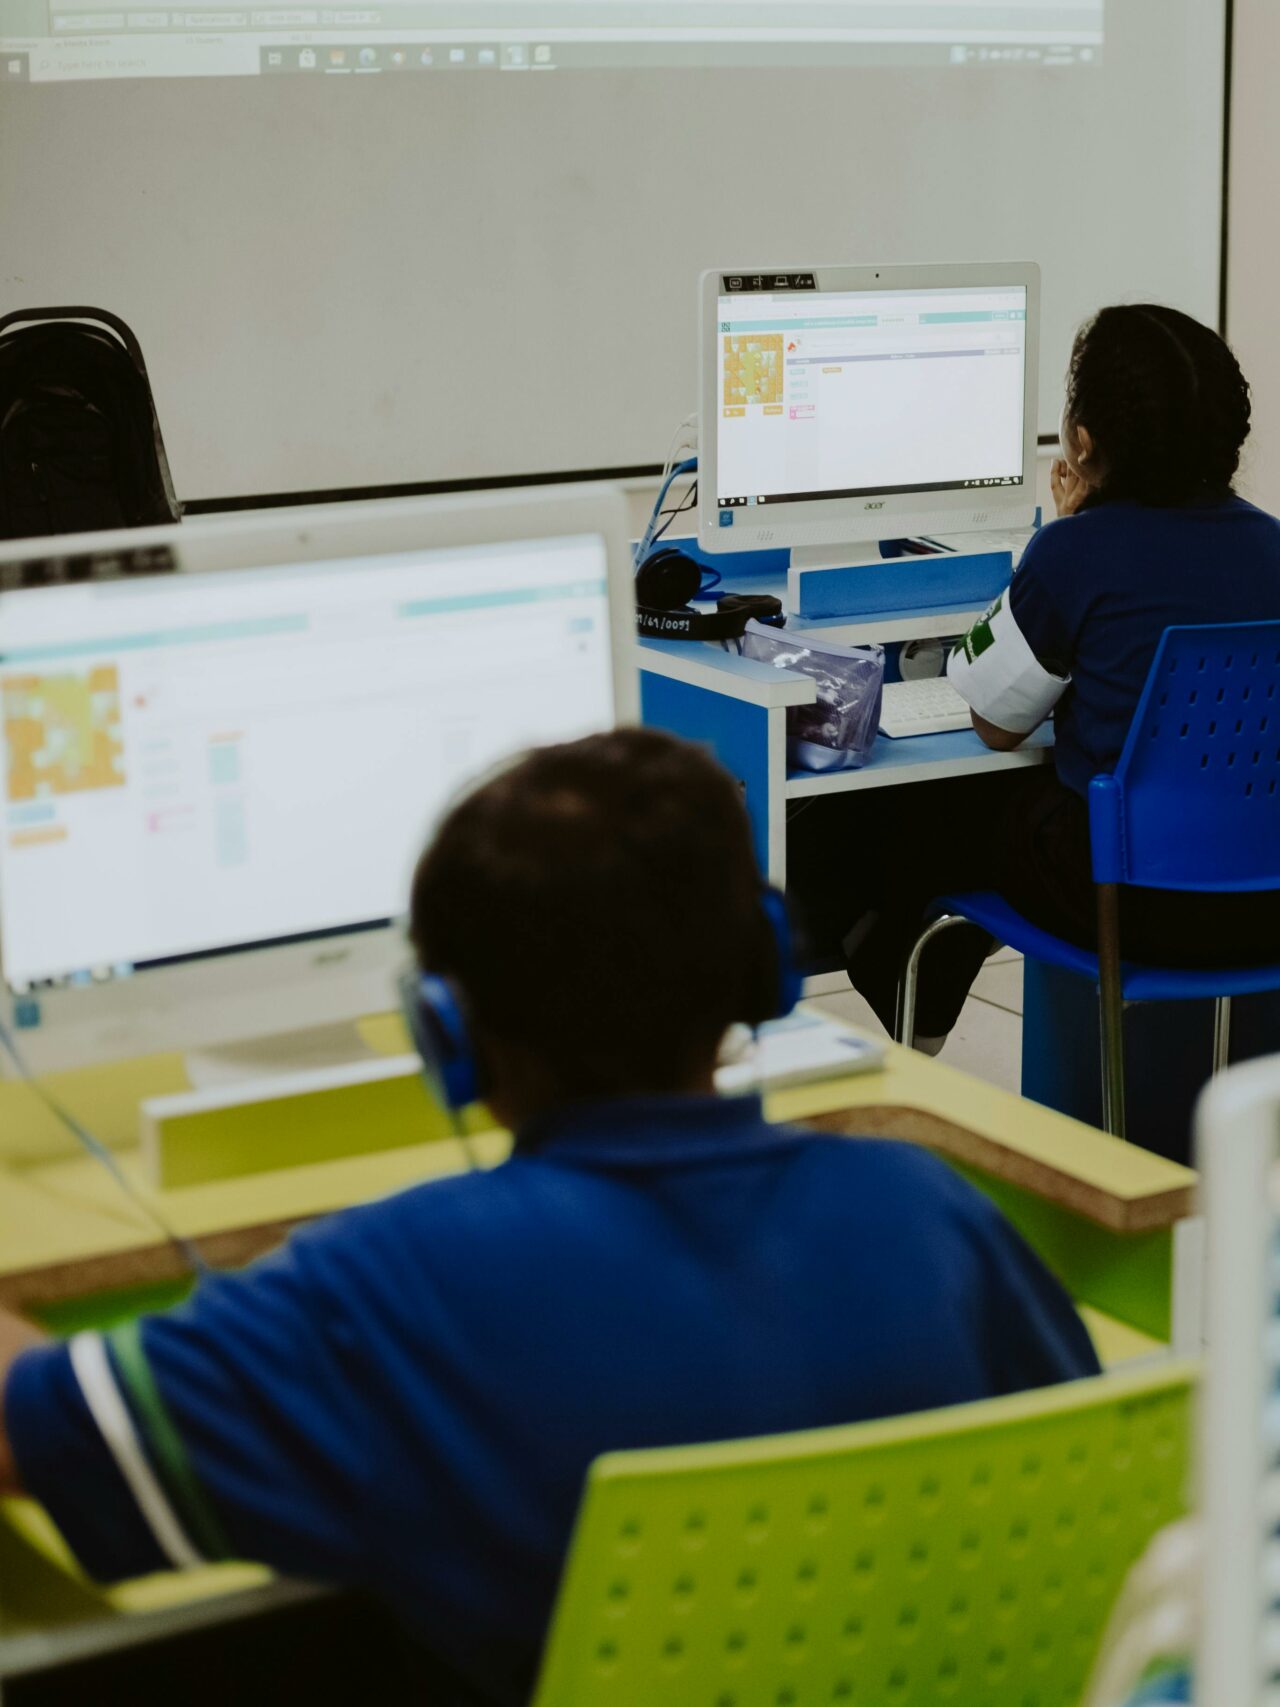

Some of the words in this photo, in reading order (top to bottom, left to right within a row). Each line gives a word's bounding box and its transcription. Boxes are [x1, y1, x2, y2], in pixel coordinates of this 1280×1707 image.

[57, 60, 80, 72] Type
[81, 59, 103, 69] here
[104, 59, 116, 68] to
[118, 57, 147, 68] search
[863, 501, 887, 511] acer
